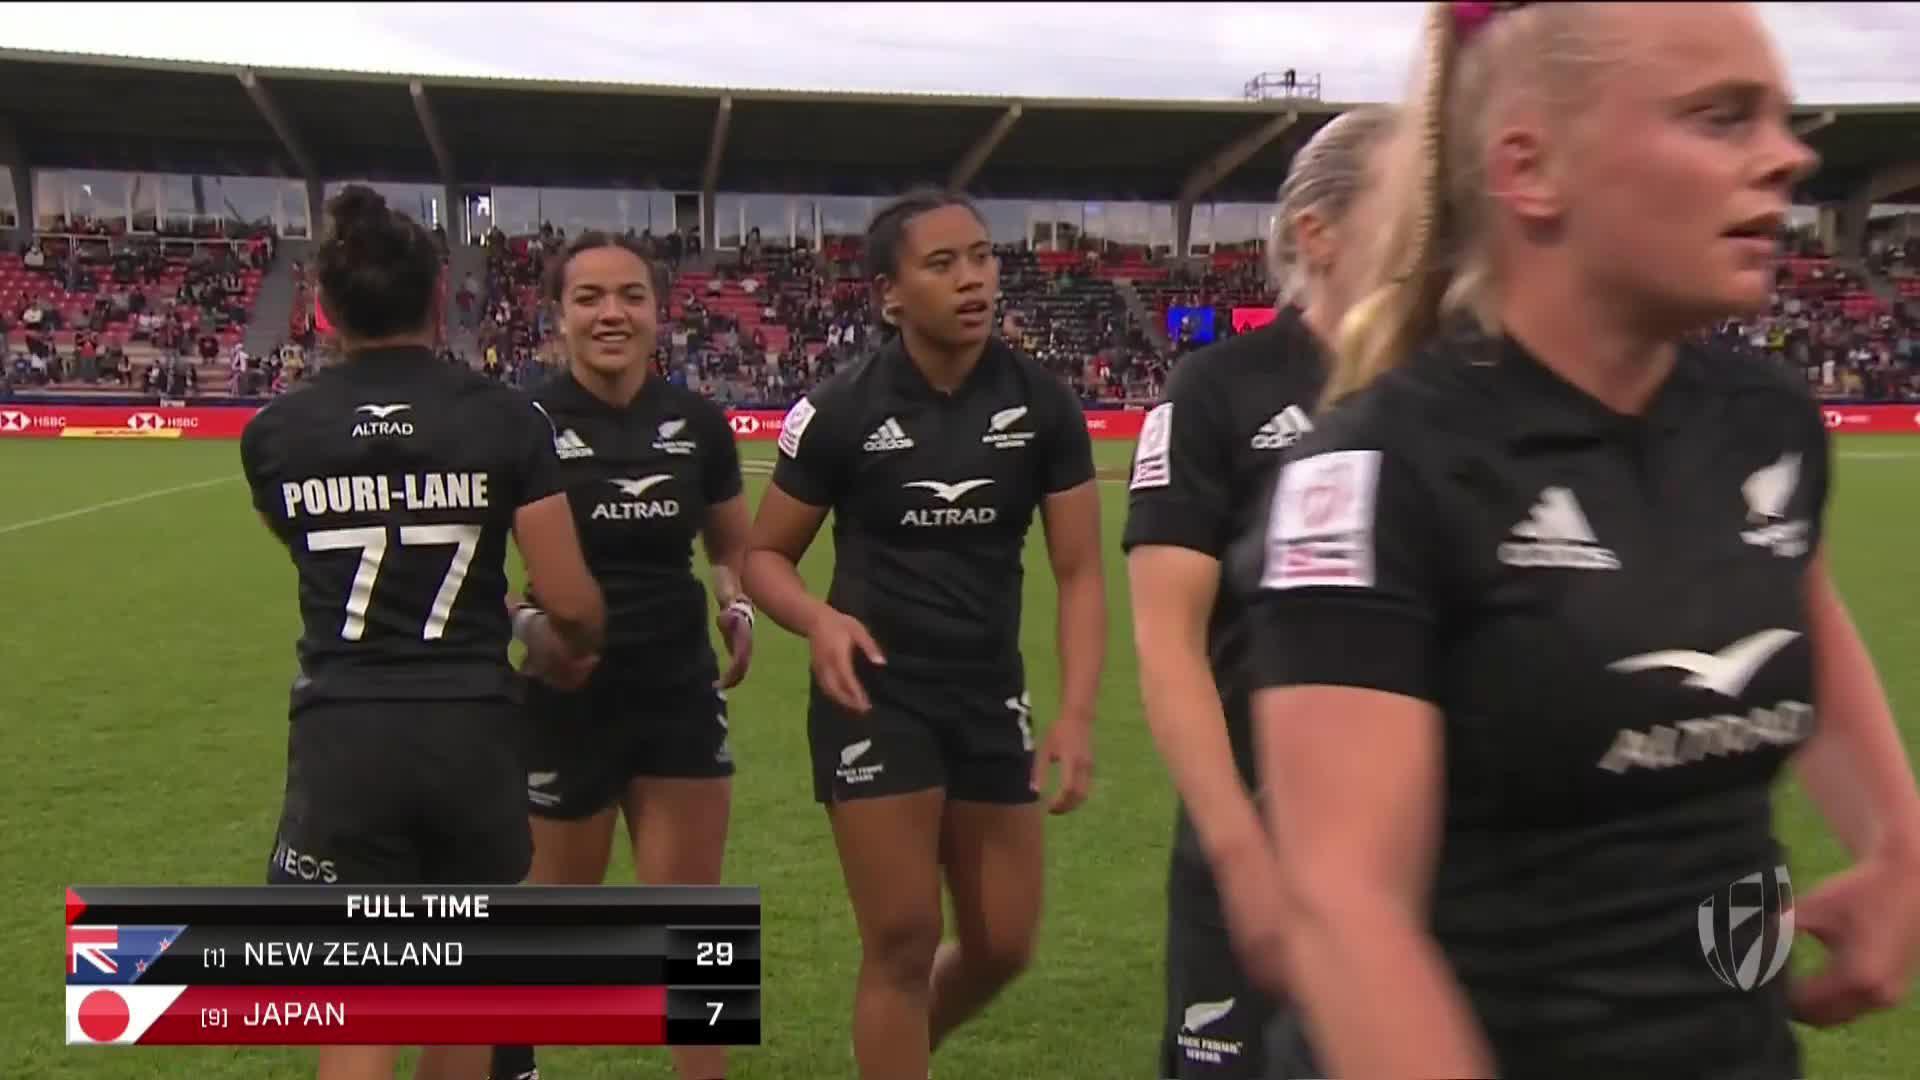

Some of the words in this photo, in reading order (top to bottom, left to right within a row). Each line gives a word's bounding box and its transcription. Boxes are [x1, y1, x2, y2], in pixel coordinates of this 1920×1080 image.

[33, 416, 67, 427] HSBC
[167, 416, 199, 428] HSBC
[351, 421, 414, 438] ALTRAD
[282, 473, 489, 518] POURI-LANE
[591, 500, 680, 520] ALTRAD
[900, 507, 997, 527] ALTRAD
[306, 524, 481, 641] 77
